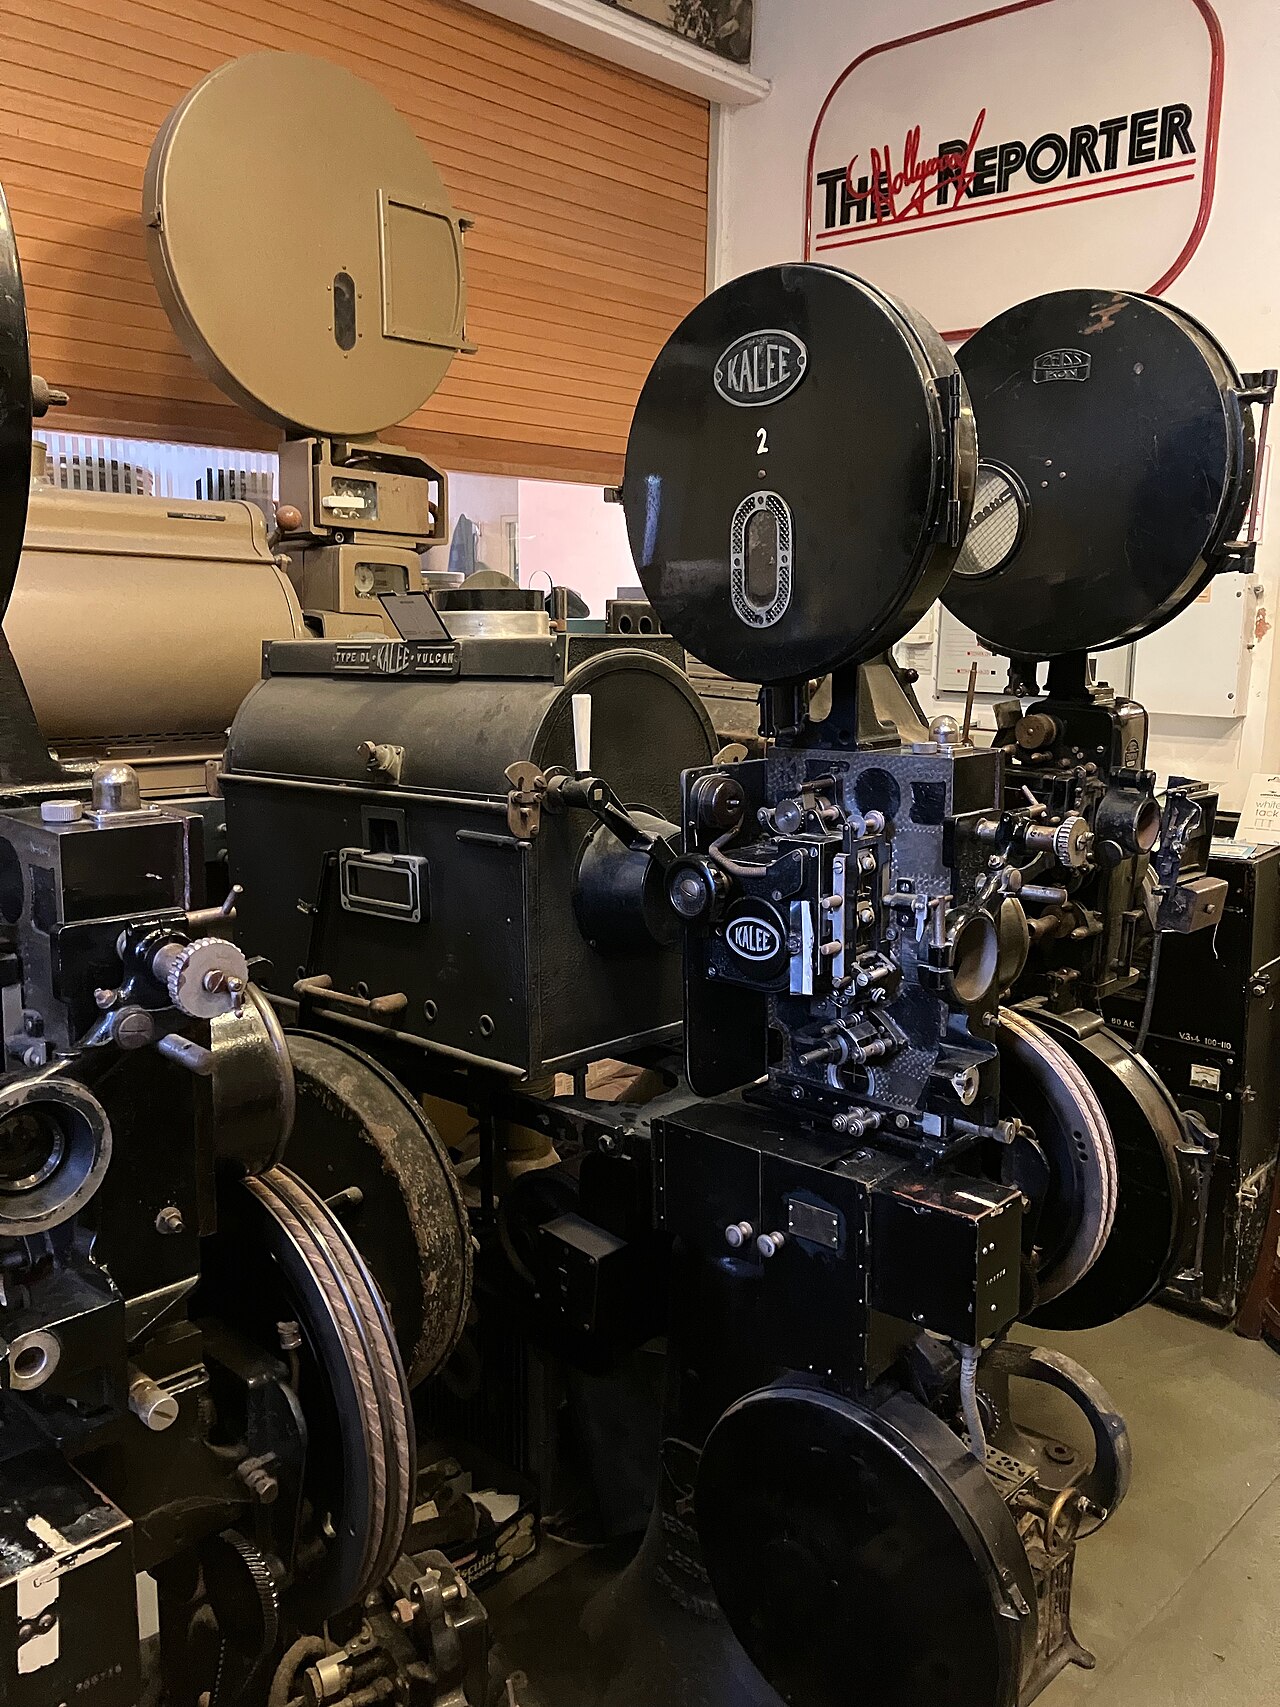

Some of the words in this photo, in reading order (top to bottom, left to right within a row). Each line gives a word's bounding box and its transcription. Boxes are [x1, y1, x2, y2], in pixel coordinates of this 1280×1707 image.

[937, 103, 1196, 206] REPORTER
[727, 344, 791, 393] KALEE
[756, 427, 769, 455] 2
[336, 652, 356, 662] TYPE
[360, 652, 370, 662] DL
[376, 643, 410, 673] KALEE
[417, 652, 454, 664] VULCAN
[735, 925, 771, 952] KALEE
